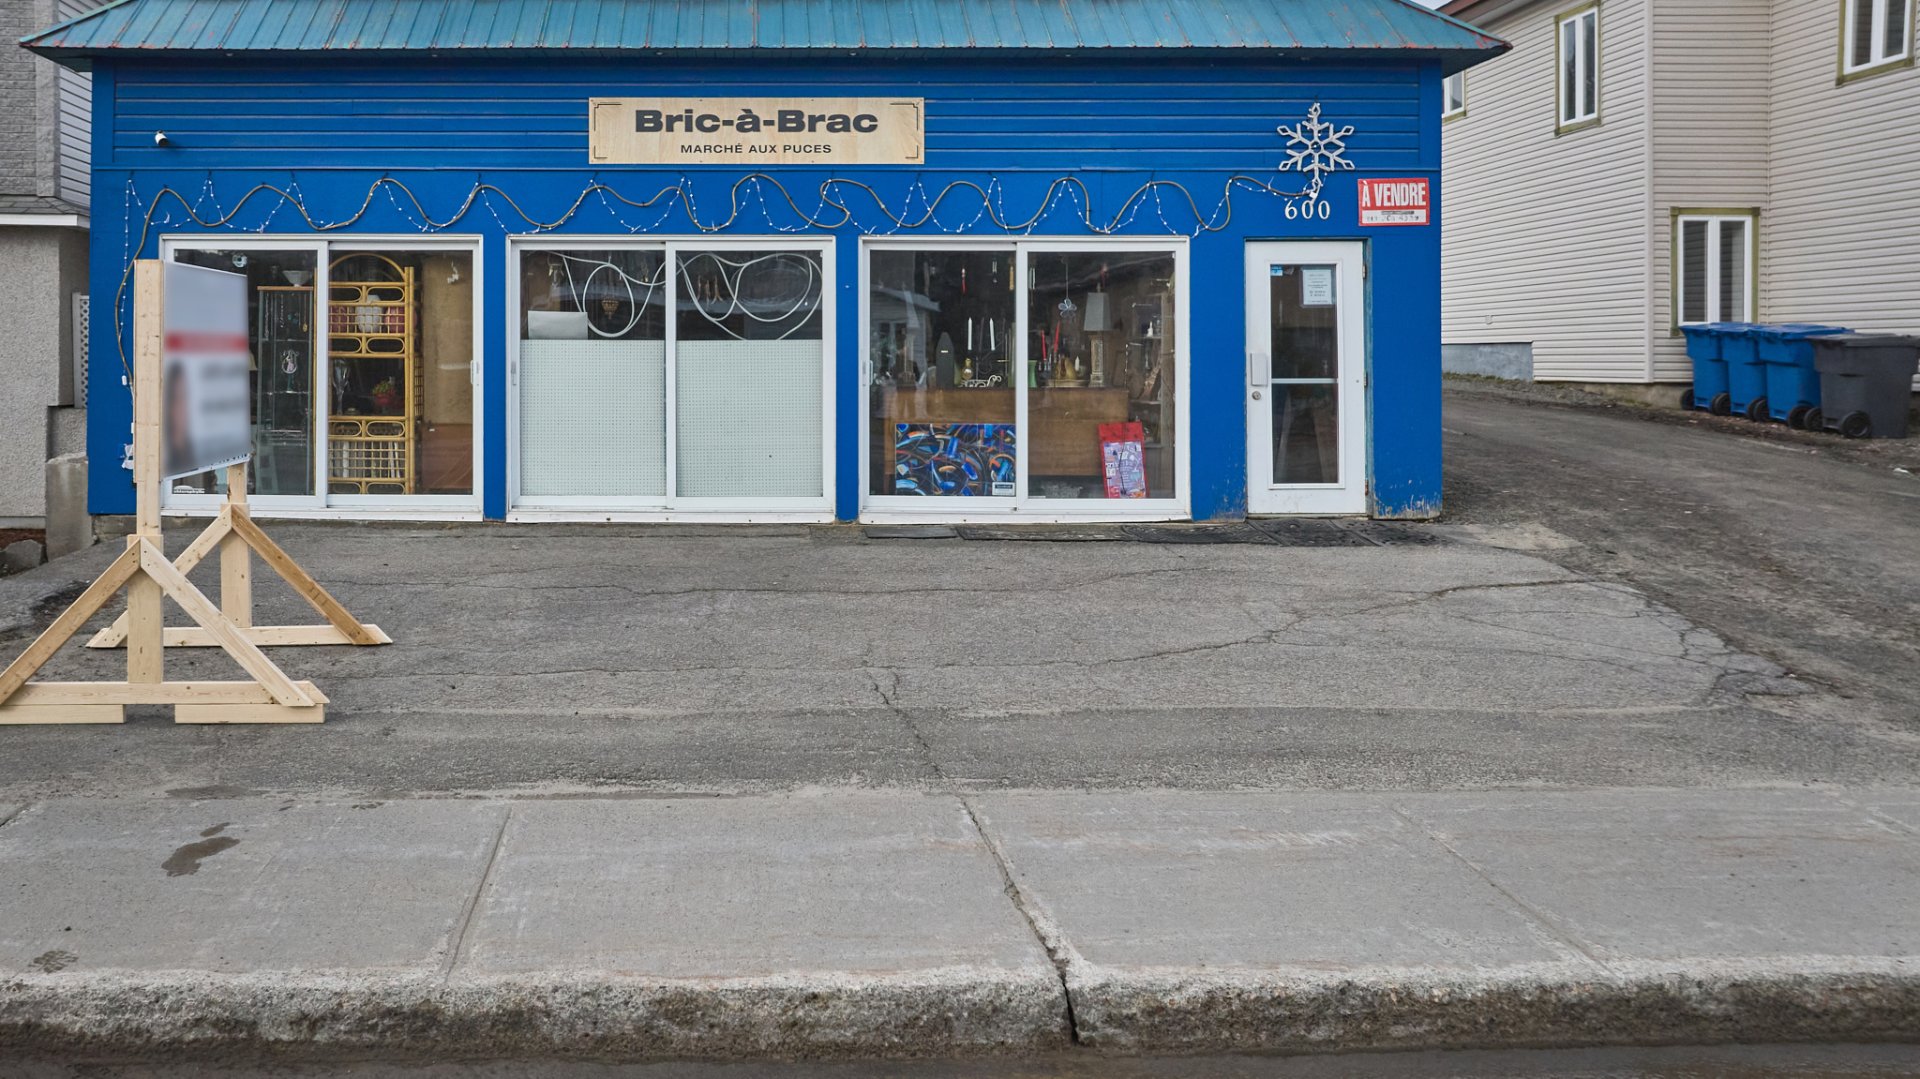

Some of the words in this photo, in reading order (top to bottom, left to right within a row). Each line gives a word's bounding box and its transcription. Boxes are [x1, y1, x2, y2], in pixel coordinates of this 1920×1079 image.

[635, 108, 879, 133] Bric-à-Brac
[680, 143, 743, 154] MARCHÉ
[748, 145, 777, 154] AUX
[783, 145, 832, 154] PUCES
[1362, 180, 1371, 208] À
[1373, 182, 1427, 207] VENDRE
[1284, 200, 1331, 220] 600
